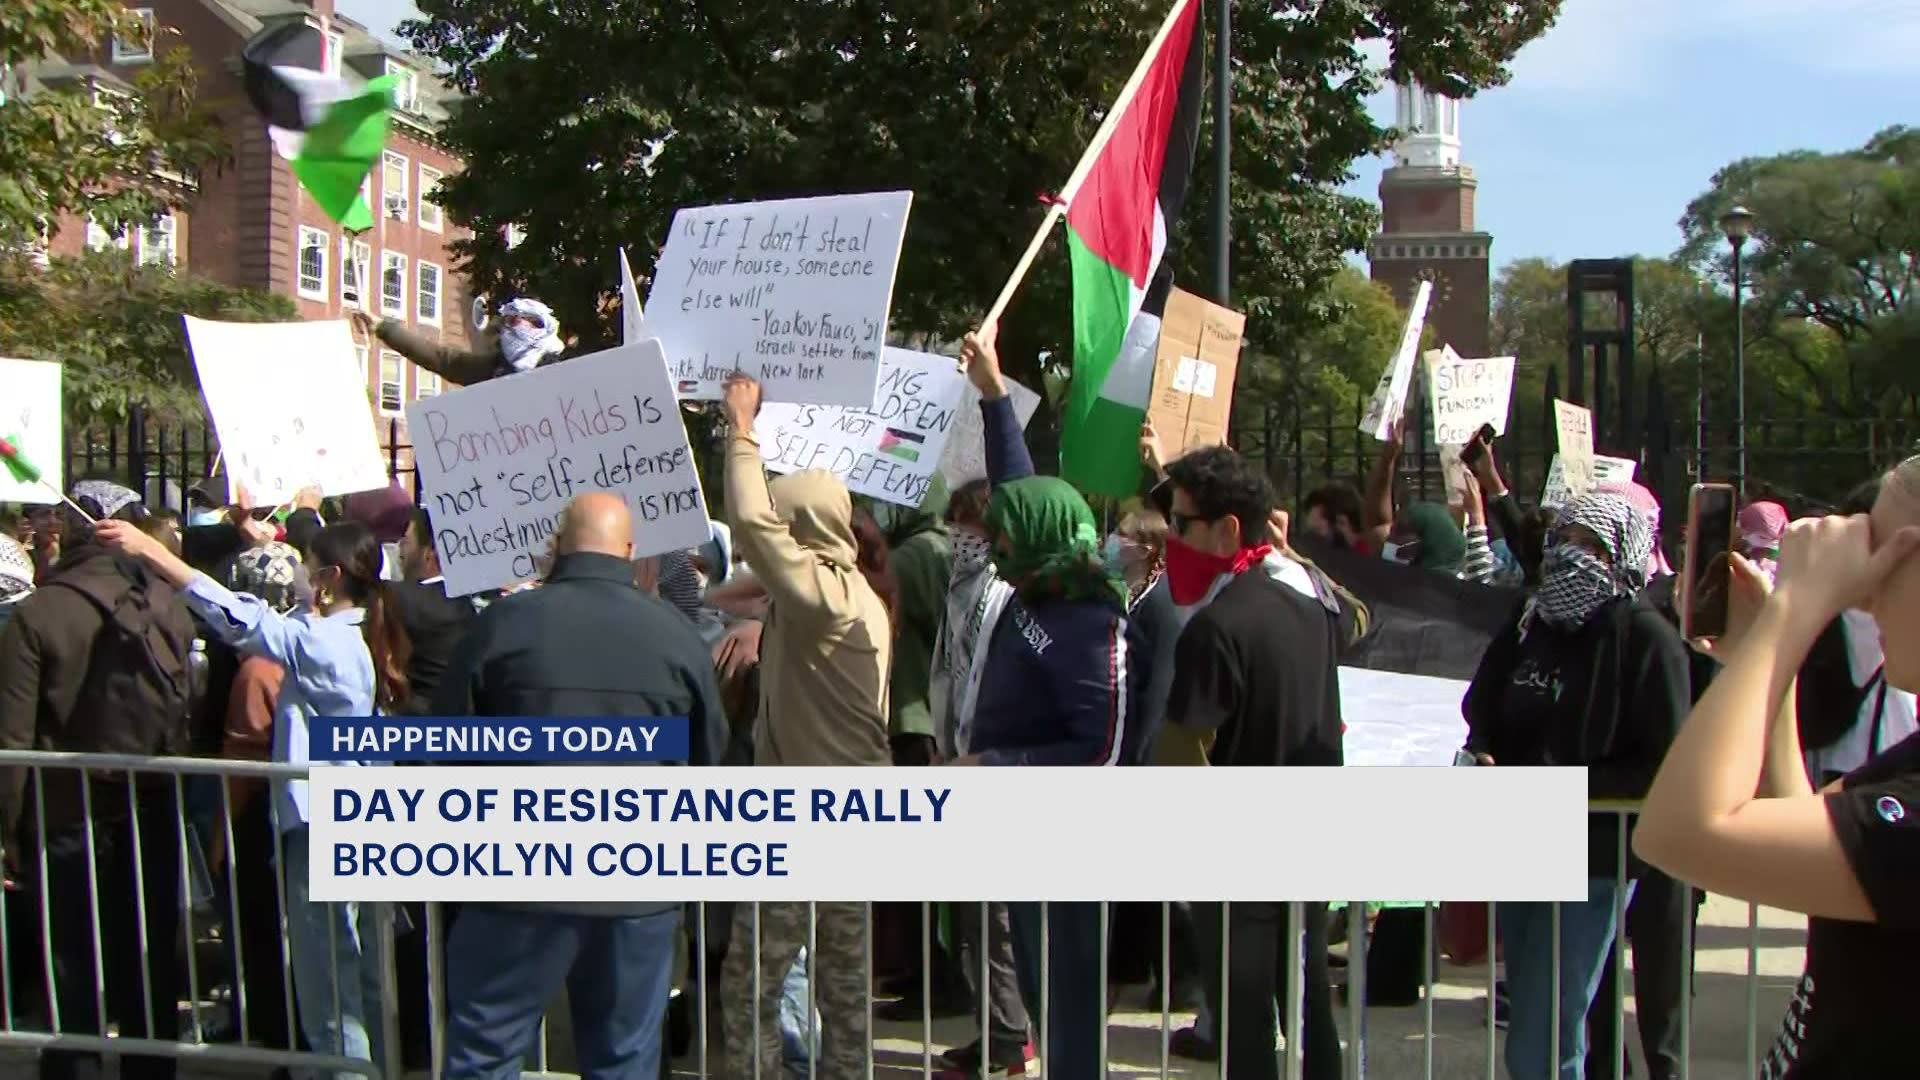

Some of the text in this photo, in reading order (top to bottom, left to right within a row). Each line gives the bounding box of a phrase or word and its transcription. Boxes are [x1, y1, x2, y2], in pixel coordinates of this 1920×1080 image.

[739, 217, 755, 249] I
[760, 215, 809, 252] don't
[817, 216, 872, 253] steal
[687, 254, 874, 287] your house, someone
[681, 288, 721, 312] else
[853, 345, 876, 362] from
[760, 363, 825, 380] New York
[559, 389, 627, 443] Kids
[793, 405, 876, 437] IS NOT
[436, 477, 488, 516] not
[640, 496, 658, 522] is
[665, 486, 700, 515] not
